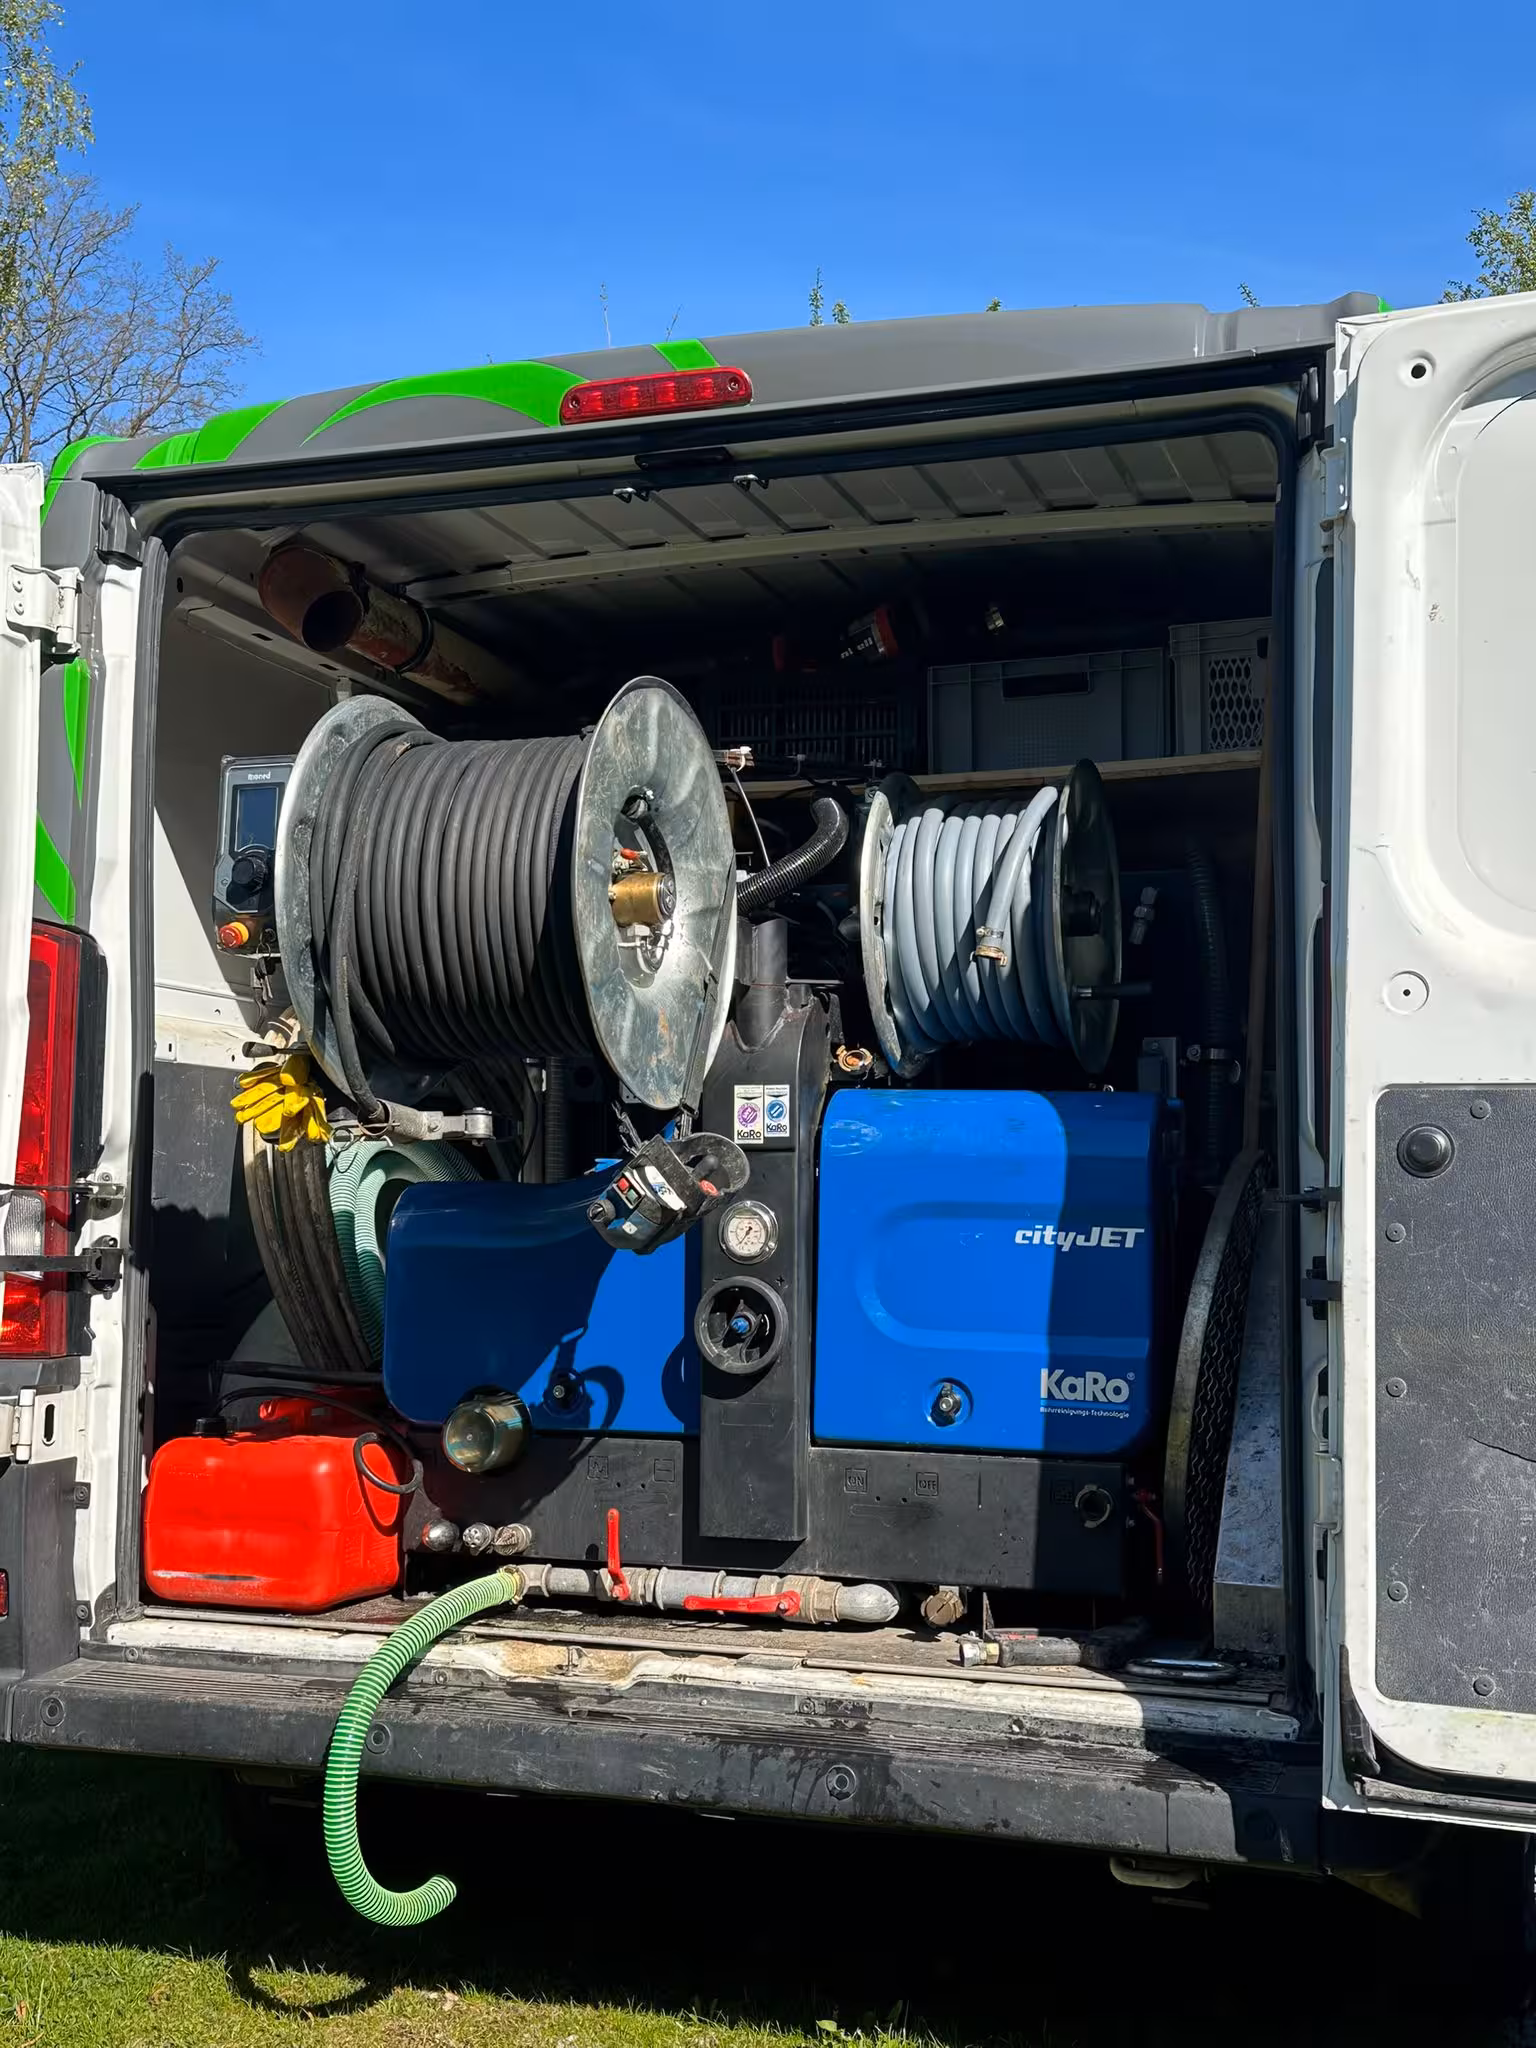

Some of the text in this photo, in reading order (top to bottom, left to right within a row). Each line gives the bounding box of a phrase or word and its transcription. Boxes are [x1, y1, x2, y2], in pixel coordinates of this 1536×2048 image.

[766, 1123, 788, 1132] KaRo
[737, 1129, 762, 1138] KaRo
[1014, 1225, 1145, 1252] cityJET
[847, 1475, 865, 1486] ON
[918, 1480, 937, 1490] OFF
